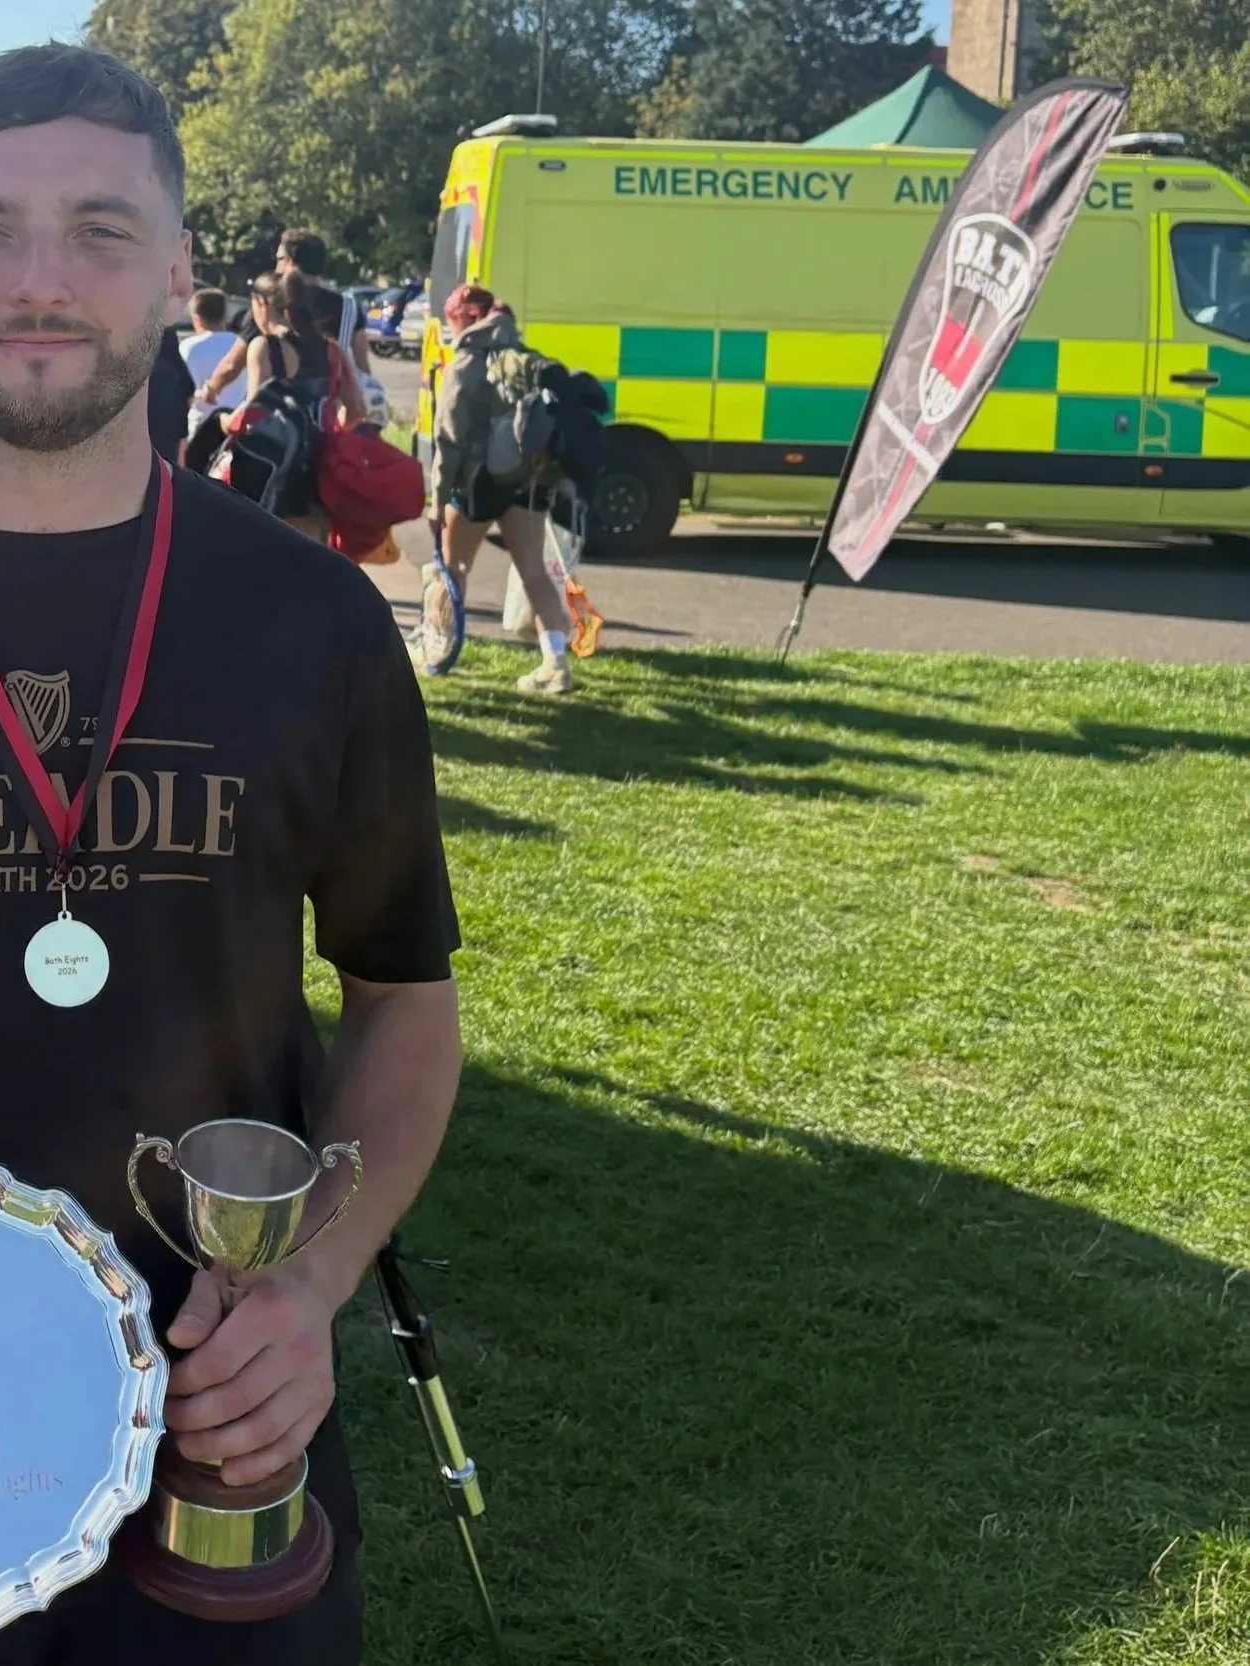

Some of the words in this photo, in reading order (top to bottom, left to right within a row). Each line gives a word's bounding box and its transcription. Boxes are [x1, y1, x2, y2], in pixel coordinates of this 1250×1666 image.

[614, 166, 853, 200] EMERGENCY
[46, 864, 129, 891] 2026
[44, 957, 63, 965] Bath
[64, 955, 89, 965] Eights
[58, 967, 78, 975] 2026
